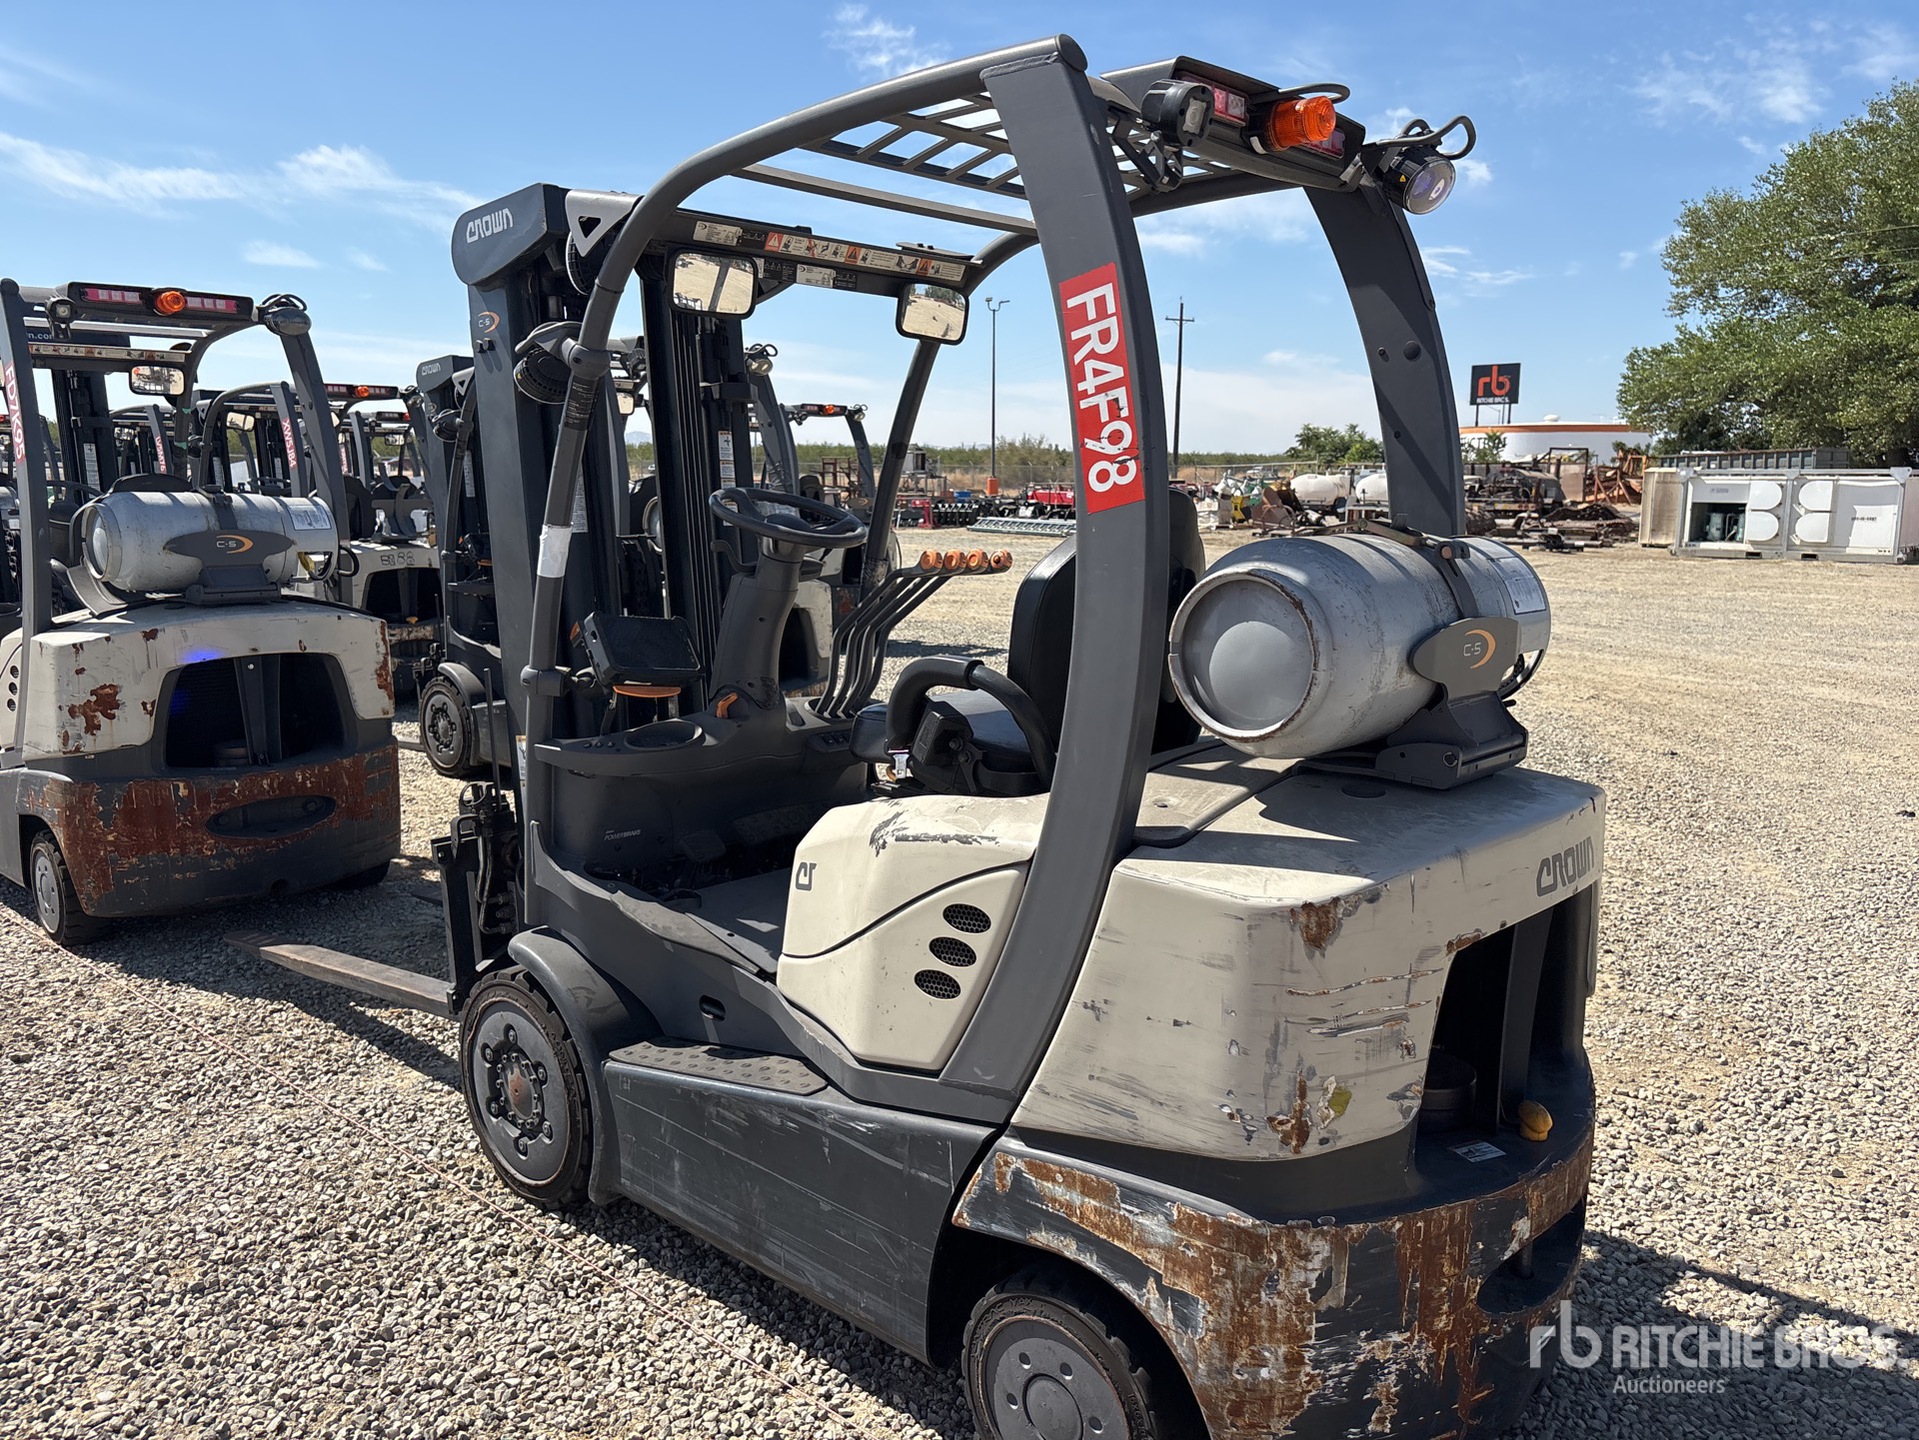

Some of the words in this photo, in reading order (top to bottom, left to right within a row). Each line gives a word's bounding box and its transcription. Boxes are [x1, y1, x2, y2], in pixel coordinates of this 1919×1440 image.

[5, 365, 26, 460] FD7K95
[1066, 282, 1138, 493] FR4F98
[1477, 365, 1511, 397] rb
[1536, 835, 1595, 898] CROWN
